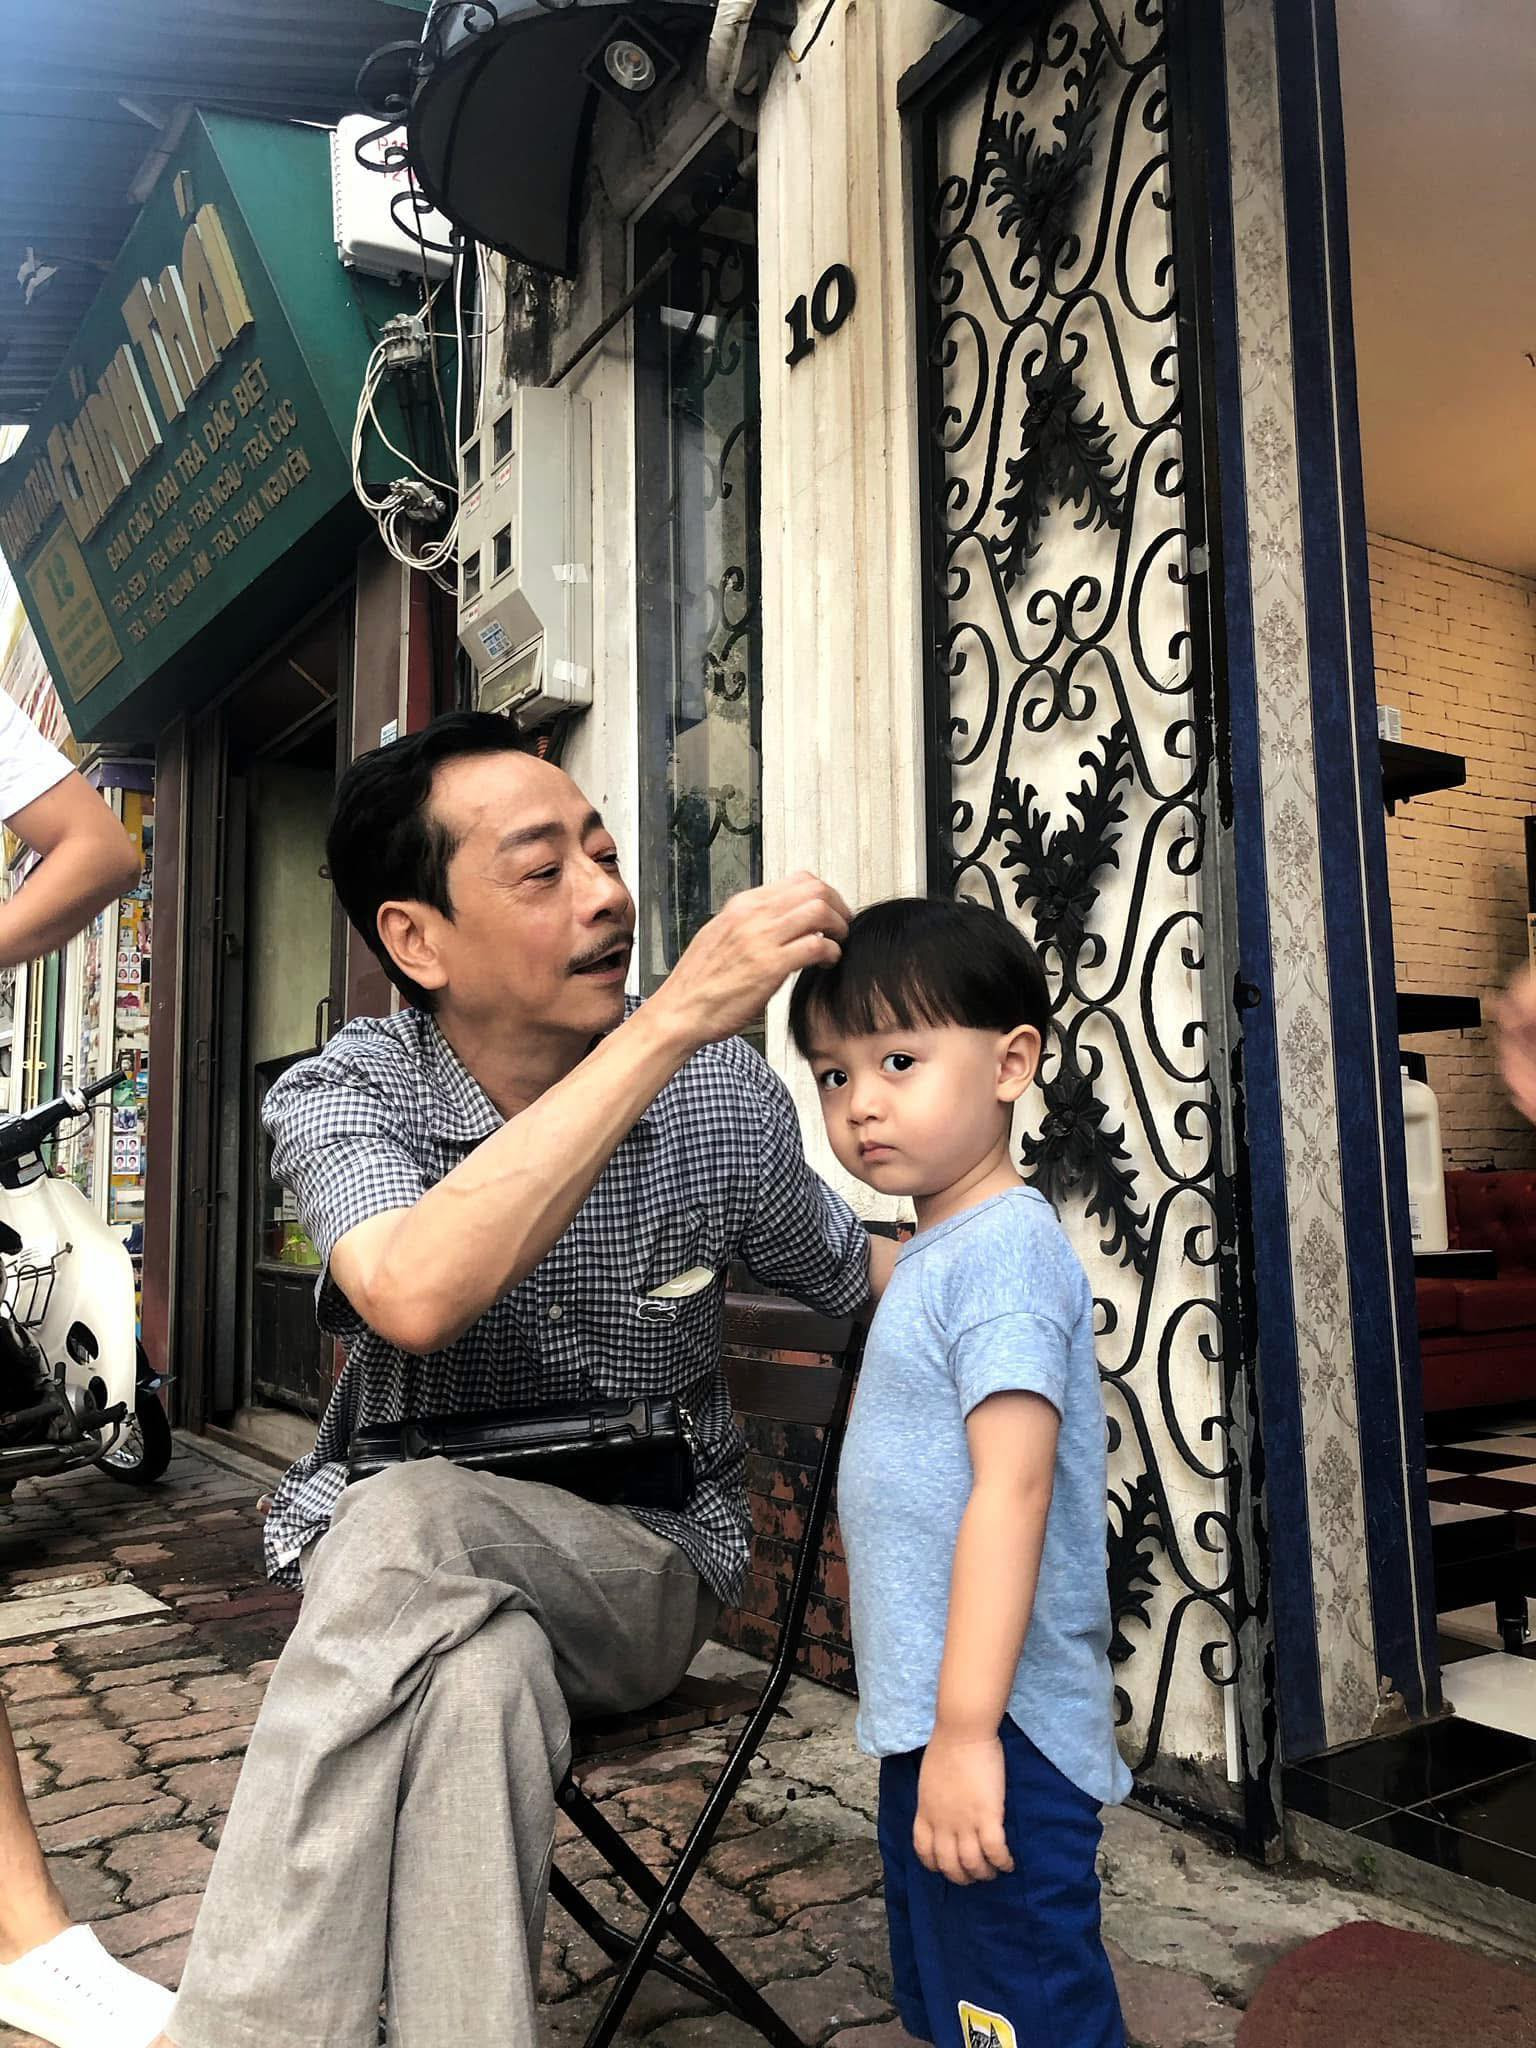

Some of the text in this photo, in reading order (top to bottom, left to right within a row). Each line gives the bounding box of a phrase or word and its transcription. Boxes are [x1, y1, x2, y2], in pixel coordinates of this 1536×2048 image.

[47, 364, 162, 543] CHÍNH
[120, 170, 254, 424] THÁI
[785, 263, 856, 367] 10
[174, 432, 208, 484] TRÀ
[232, 356, 269, 418] BIỆT
[147, 541, 170, 577] TRÀ
[191, 488, 213, 532] TRÀ
[243, 424, 273, 470] TRÀ
[268, 397, 297, 444] CÚC
[212, 514, 240, 559] TRÀ
[260, 446, 312, 509] NGUYÊN
